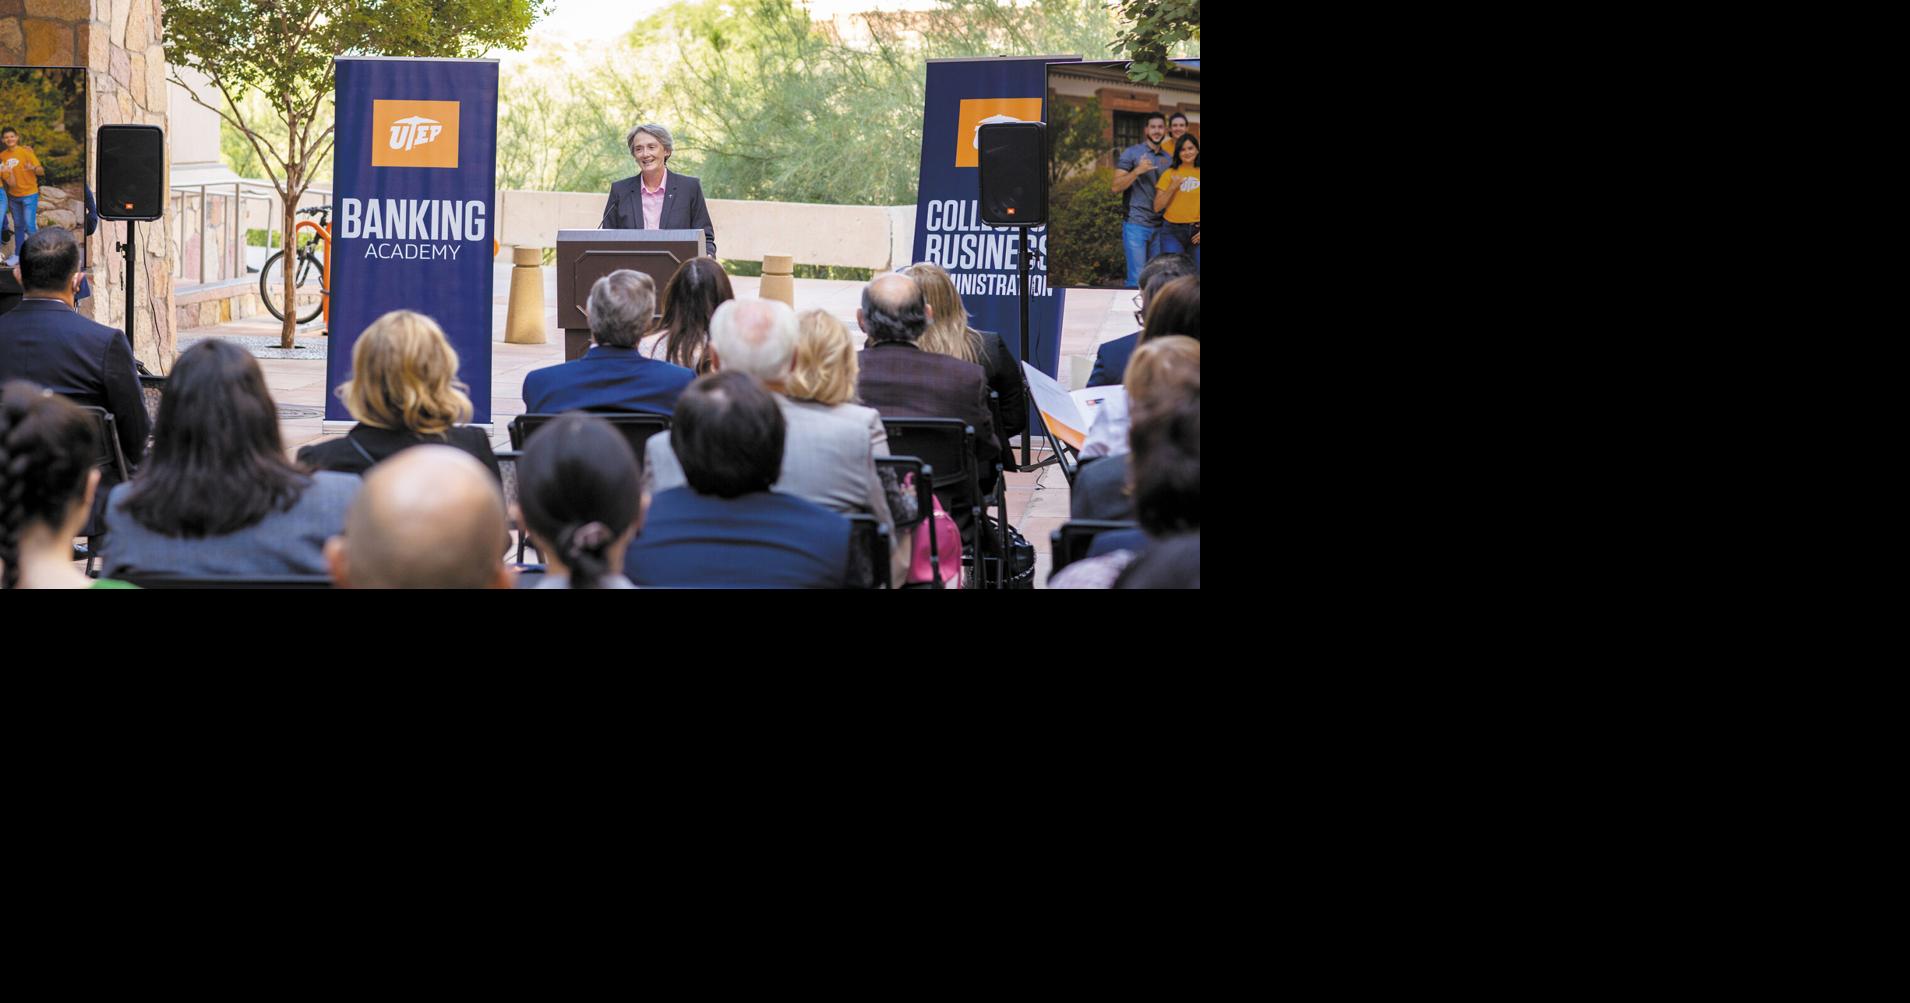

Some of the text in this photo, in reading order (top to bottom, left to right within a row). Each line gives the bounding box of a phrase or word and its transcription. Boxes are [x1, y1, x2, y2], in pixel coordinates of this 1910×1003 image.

[389, 116, 443, 151] UTEP
[341, 198, 486, 241] BANKING
[926, 199, 1020, 232] COLL
[364, 243, 461, 260] ACADEMY
